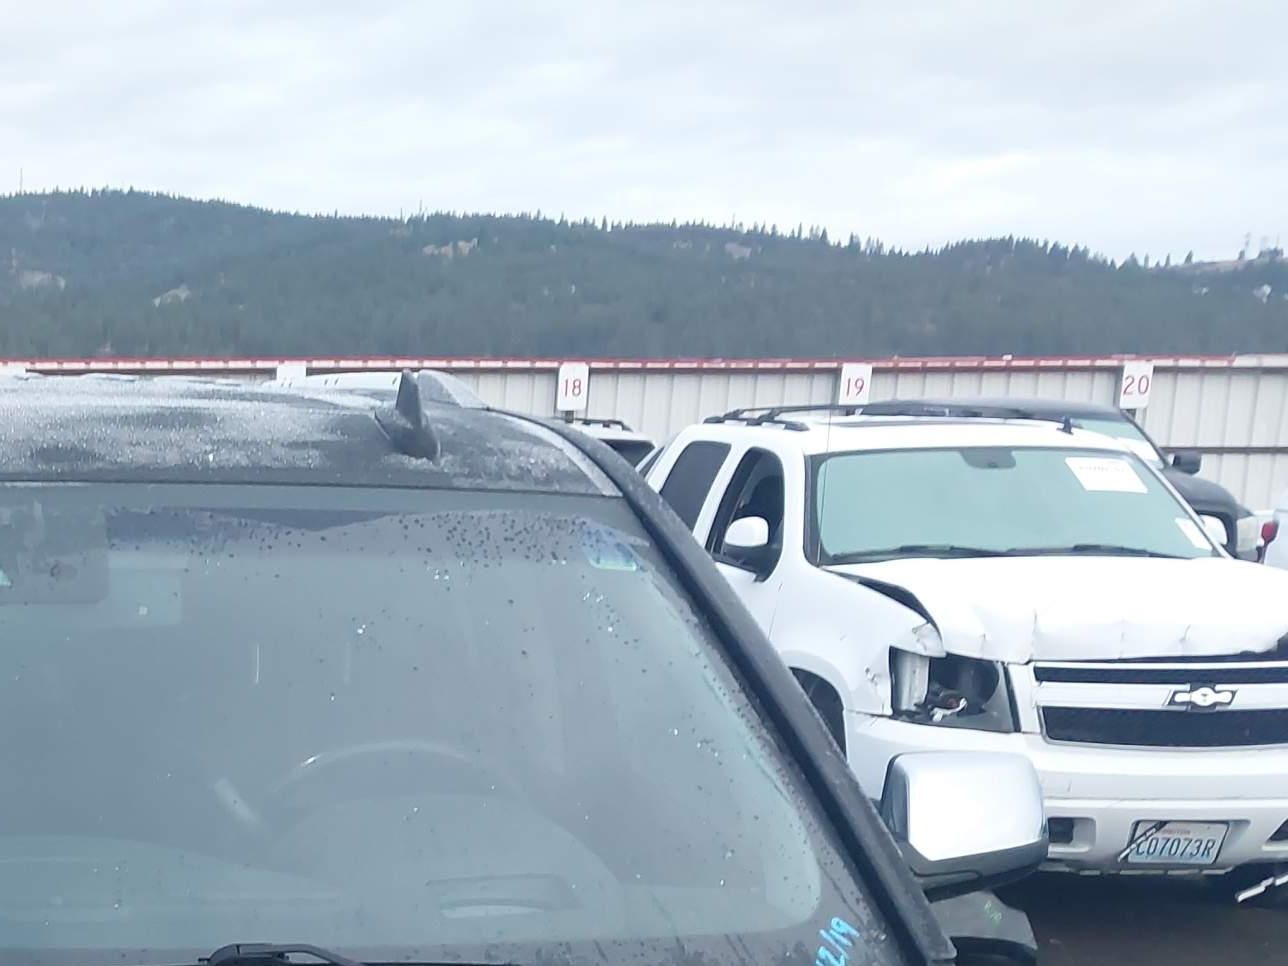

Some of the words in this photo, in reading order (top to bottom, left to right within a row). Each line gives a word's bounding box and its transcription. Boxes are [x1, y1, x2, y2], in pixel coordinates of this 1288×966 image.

[564, 378, 582, 398] 18
[846, 377, 865, 397] 19
[1123, 375, 1150, 395] 20
[1136, 837, 1217, 858] C07073R
